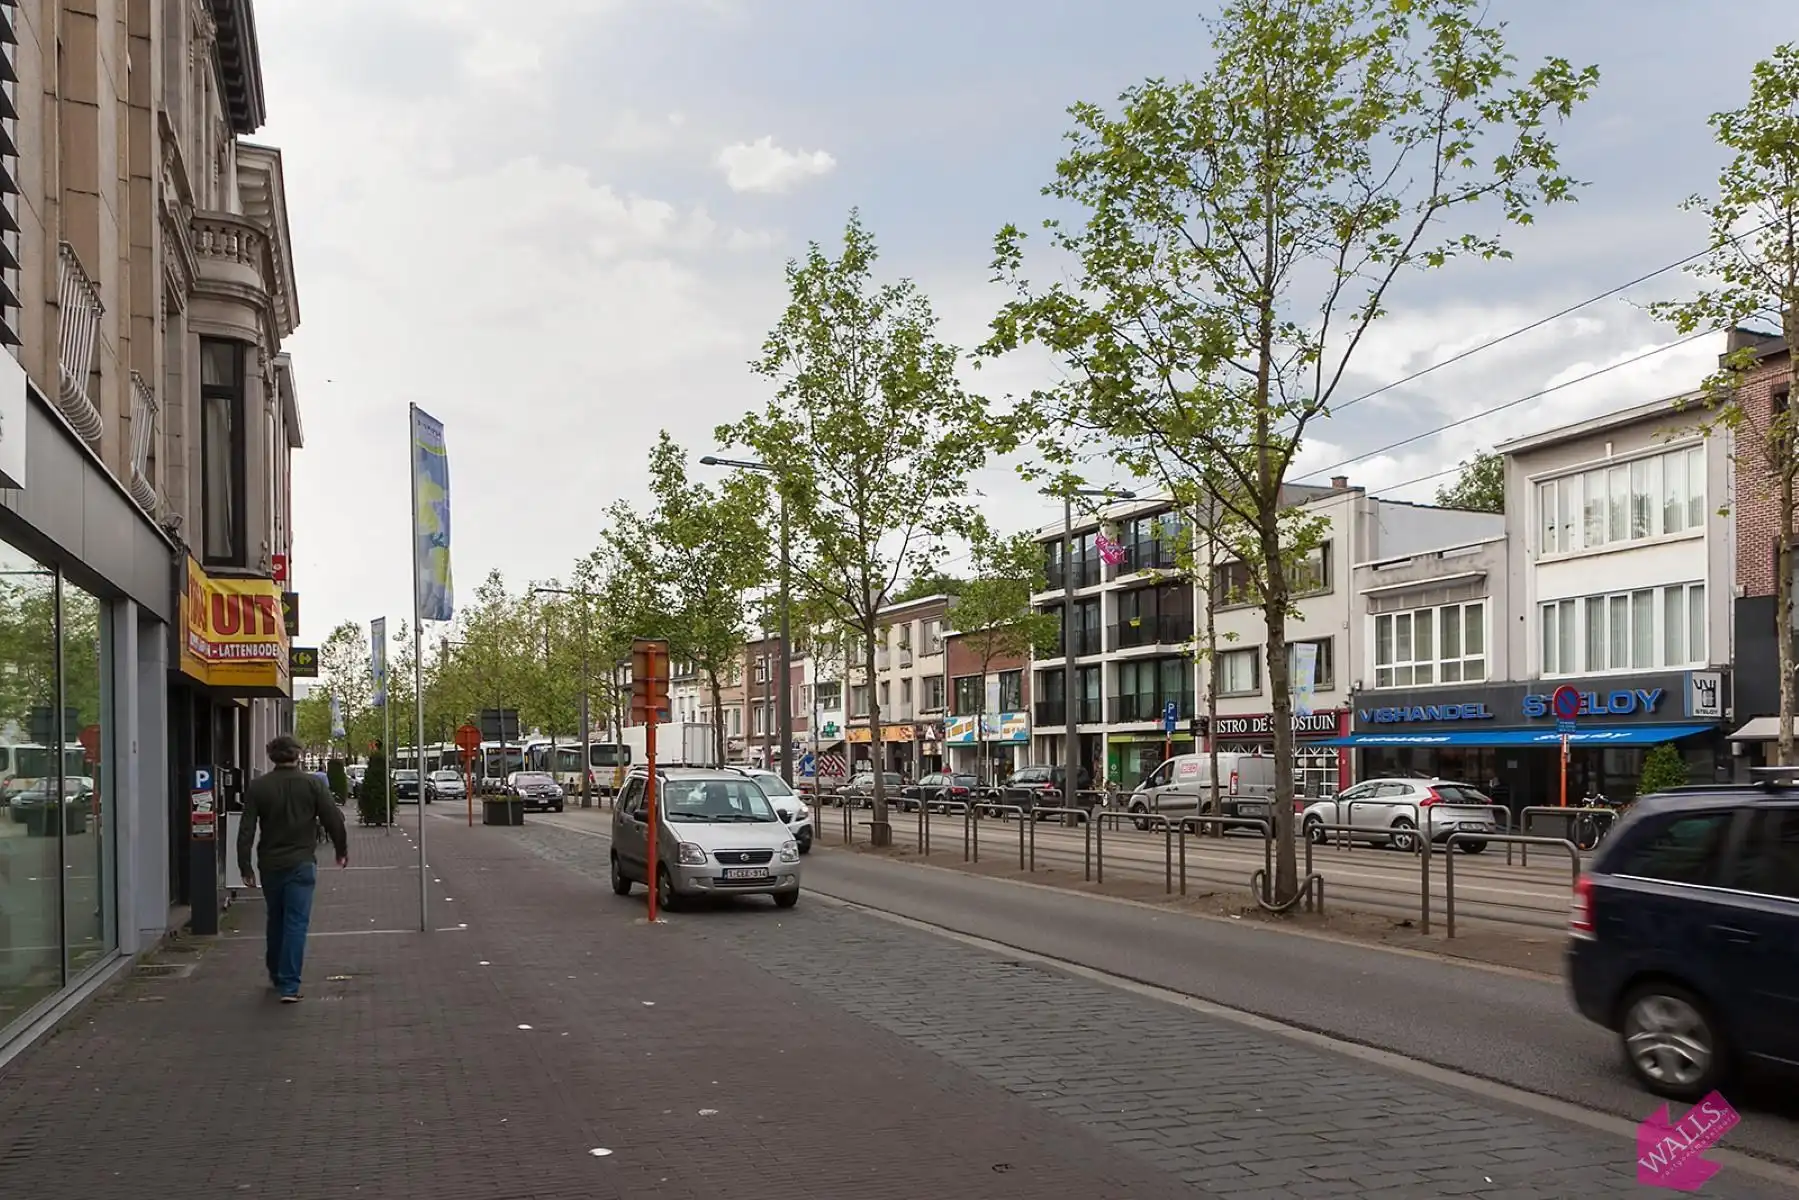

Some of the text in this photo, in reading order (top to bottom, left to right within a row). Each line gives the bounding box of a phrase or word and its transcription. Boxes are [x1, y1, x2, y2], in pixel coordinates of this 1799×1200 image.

[211, 593, 275, 635] UIT
[1168, 703, 1175, 714] P
[1360, 703, 1493, 723] VISHANDEL
[1216, 714, 1336, 733] ISTRO DE SDSTUIN
[195, 769, 210, 789] P
